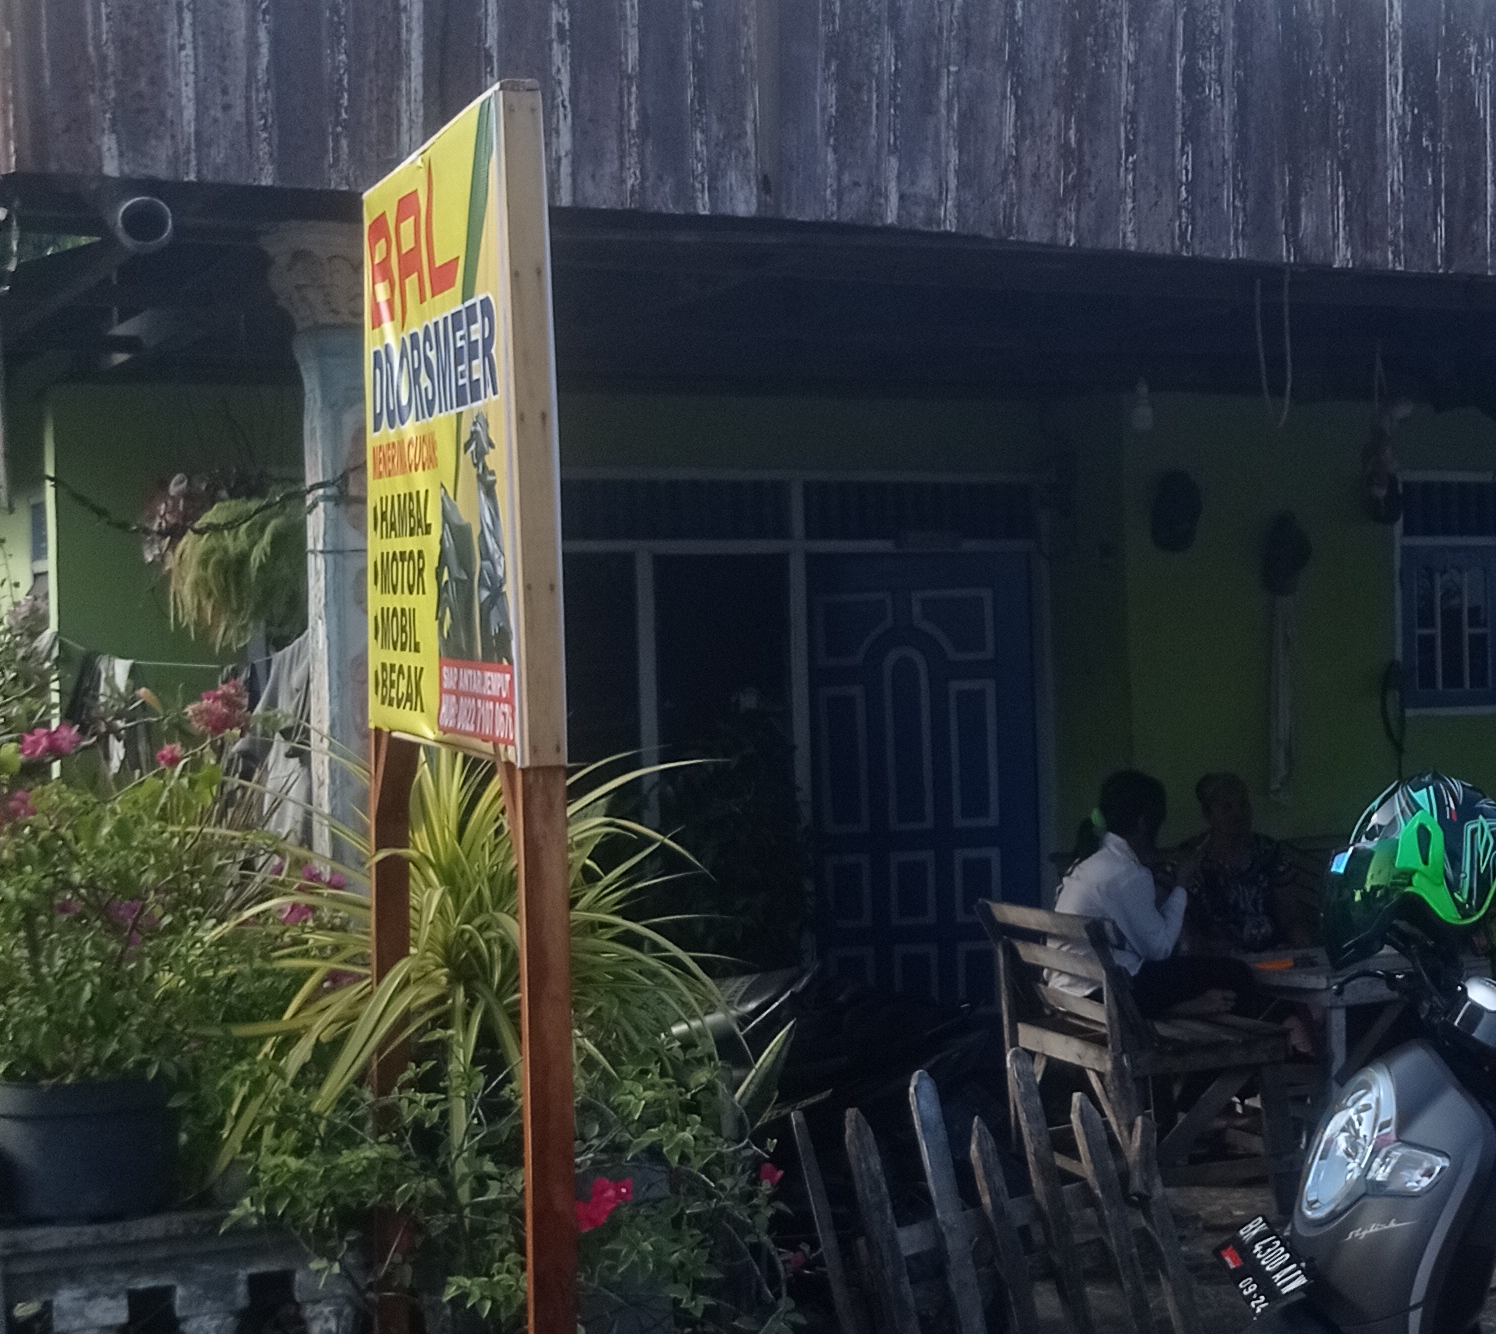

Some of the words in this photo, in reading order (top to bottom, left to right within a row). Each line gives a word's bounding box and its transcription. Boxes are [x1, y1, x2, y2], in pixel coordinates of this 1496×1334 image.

[368, 157, 460, 331] BAL
[371, 295, 499, 434] DOORSMEER
[379, 489, 432, 540] HAMBAL
[380, 550, 426, 595] MOTOR
[380, 607, 421, 653] MOBIL
[380, 664, 425, 713] BECAK
[1239, 1215, 1270, 1244] BK
[1252, 1234, 1291, 1272] 4300
